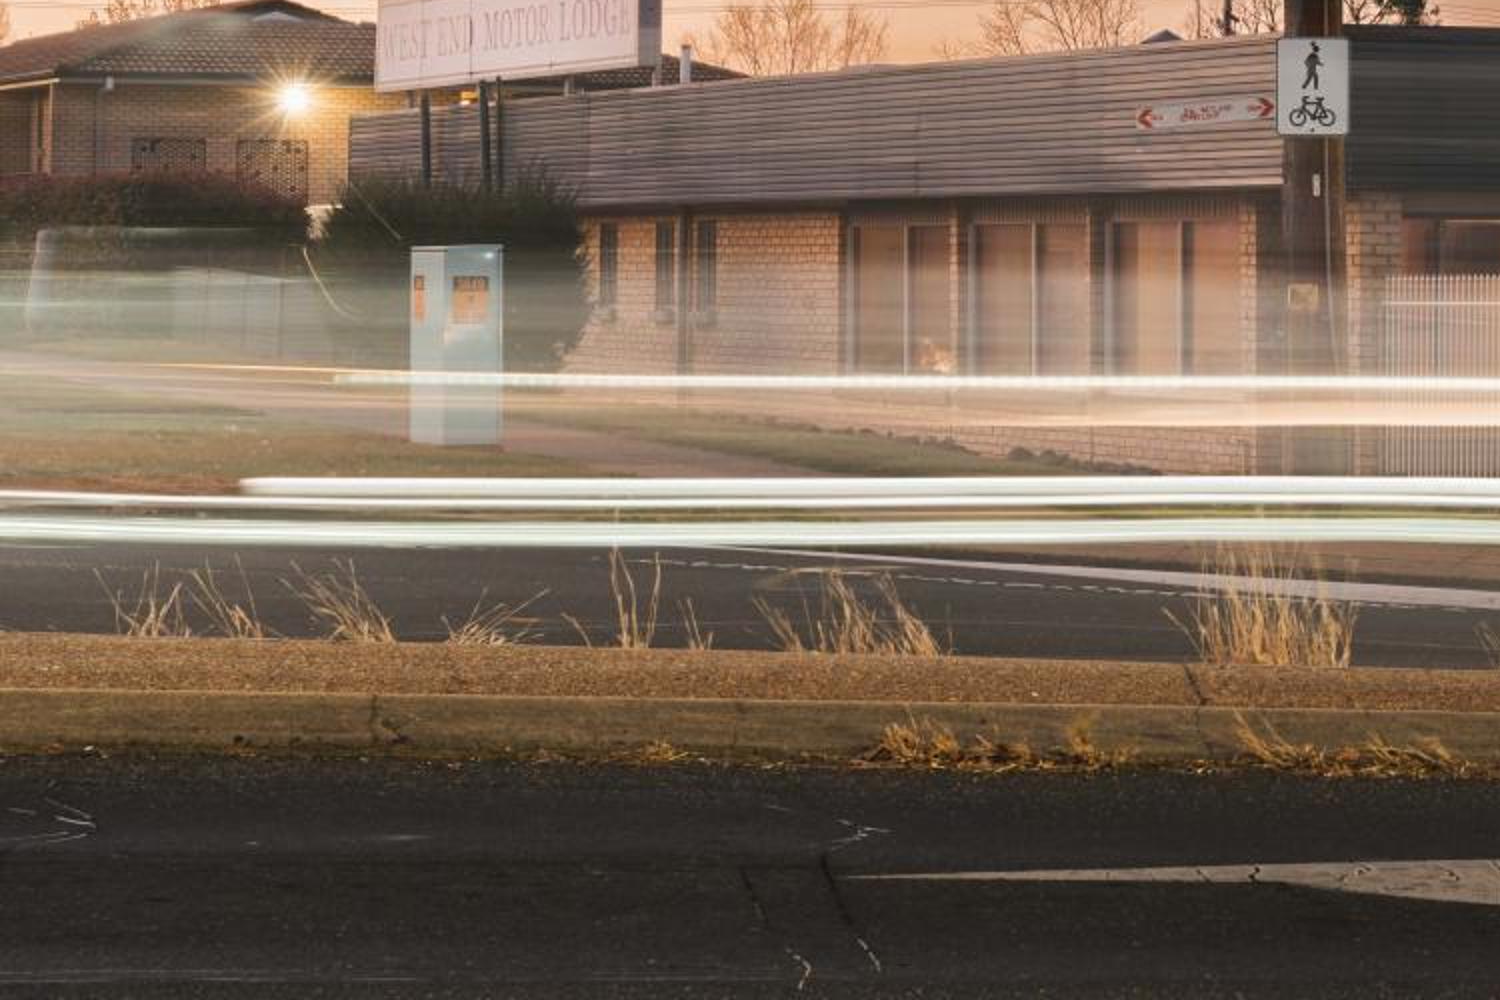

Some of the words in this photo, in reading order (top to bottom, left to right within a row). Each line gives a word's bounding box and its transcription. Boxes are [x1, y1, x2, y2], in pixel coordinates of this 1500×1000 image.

[383, 20, 432, 62] WEST
[437, 13, 472, 57] END
[482, 3, 552, 51] MOTOR
